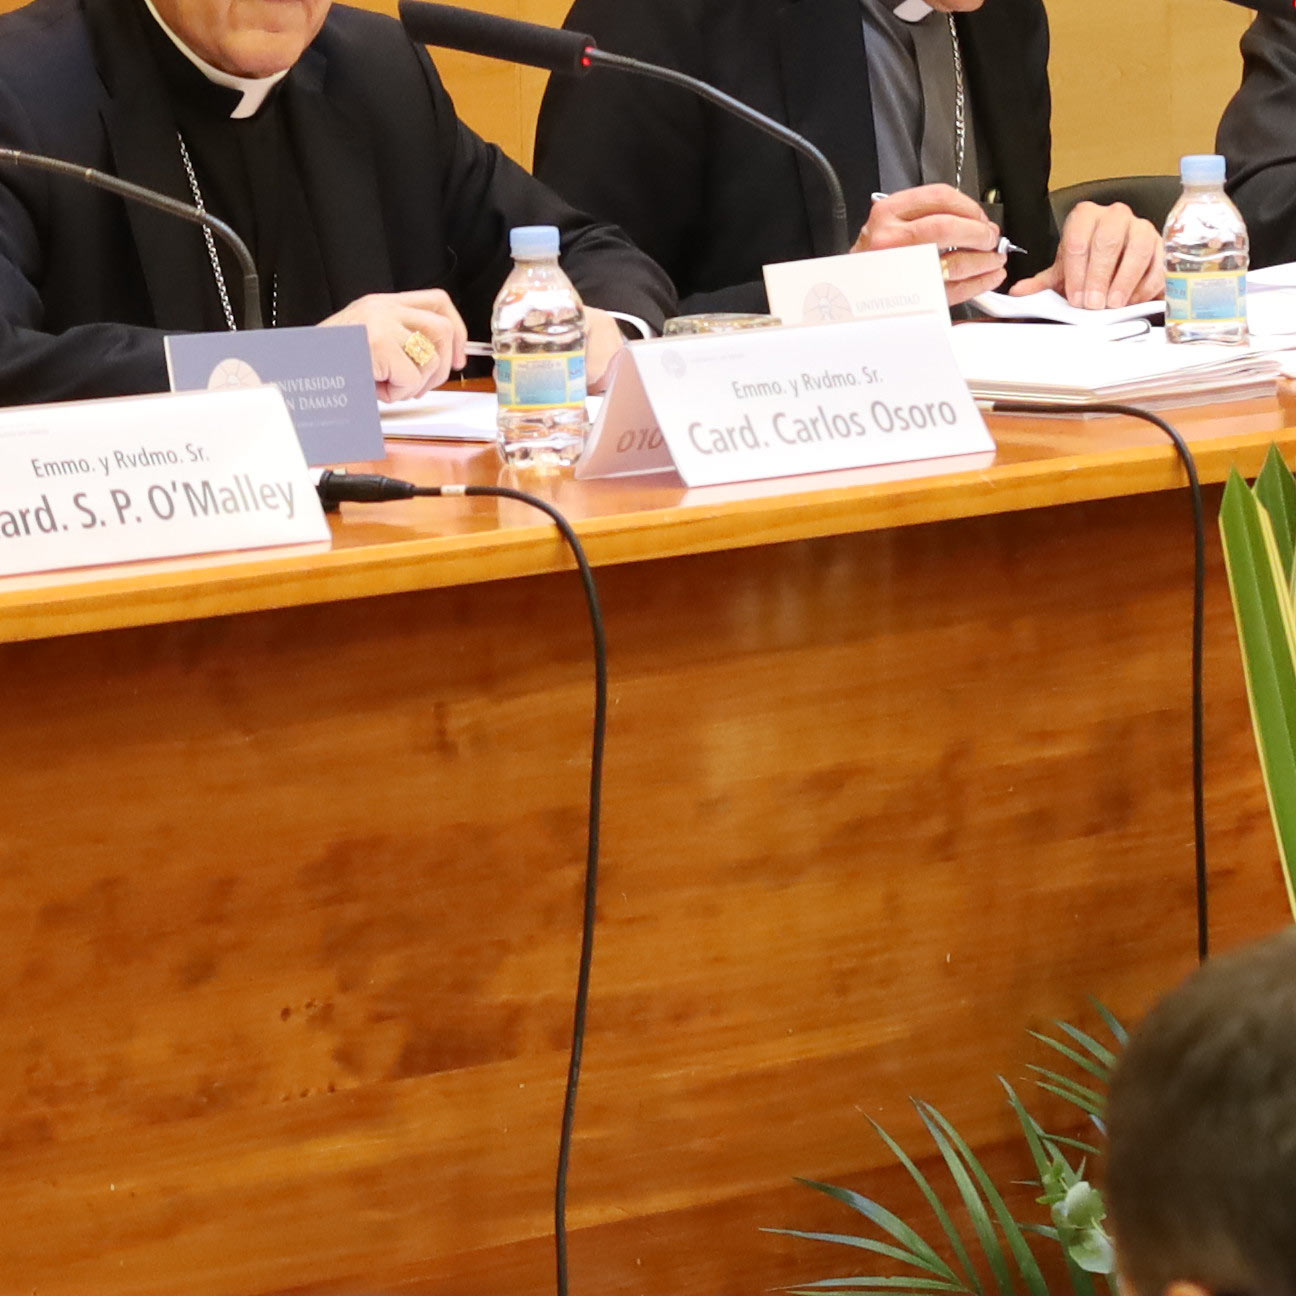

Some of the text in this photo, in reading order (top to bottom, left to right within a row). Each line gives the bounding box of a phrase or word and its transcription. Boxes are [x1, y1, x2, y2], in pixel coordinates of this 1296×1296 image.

[275, 376, 345, 392] NIVERSIDAD
[732, 366, 884, 399] Emmo. y Rvdmo. Sr.
[689, 395, 958, 454] Card. Carlos Osoro
[31, 442, 210, 478] Emmo. y Rvdmo. Sr.
[73, 491, 106, 529] S.
[115, 488, 142, 523] P.
[148, 474, 295, 520] O'Malley
